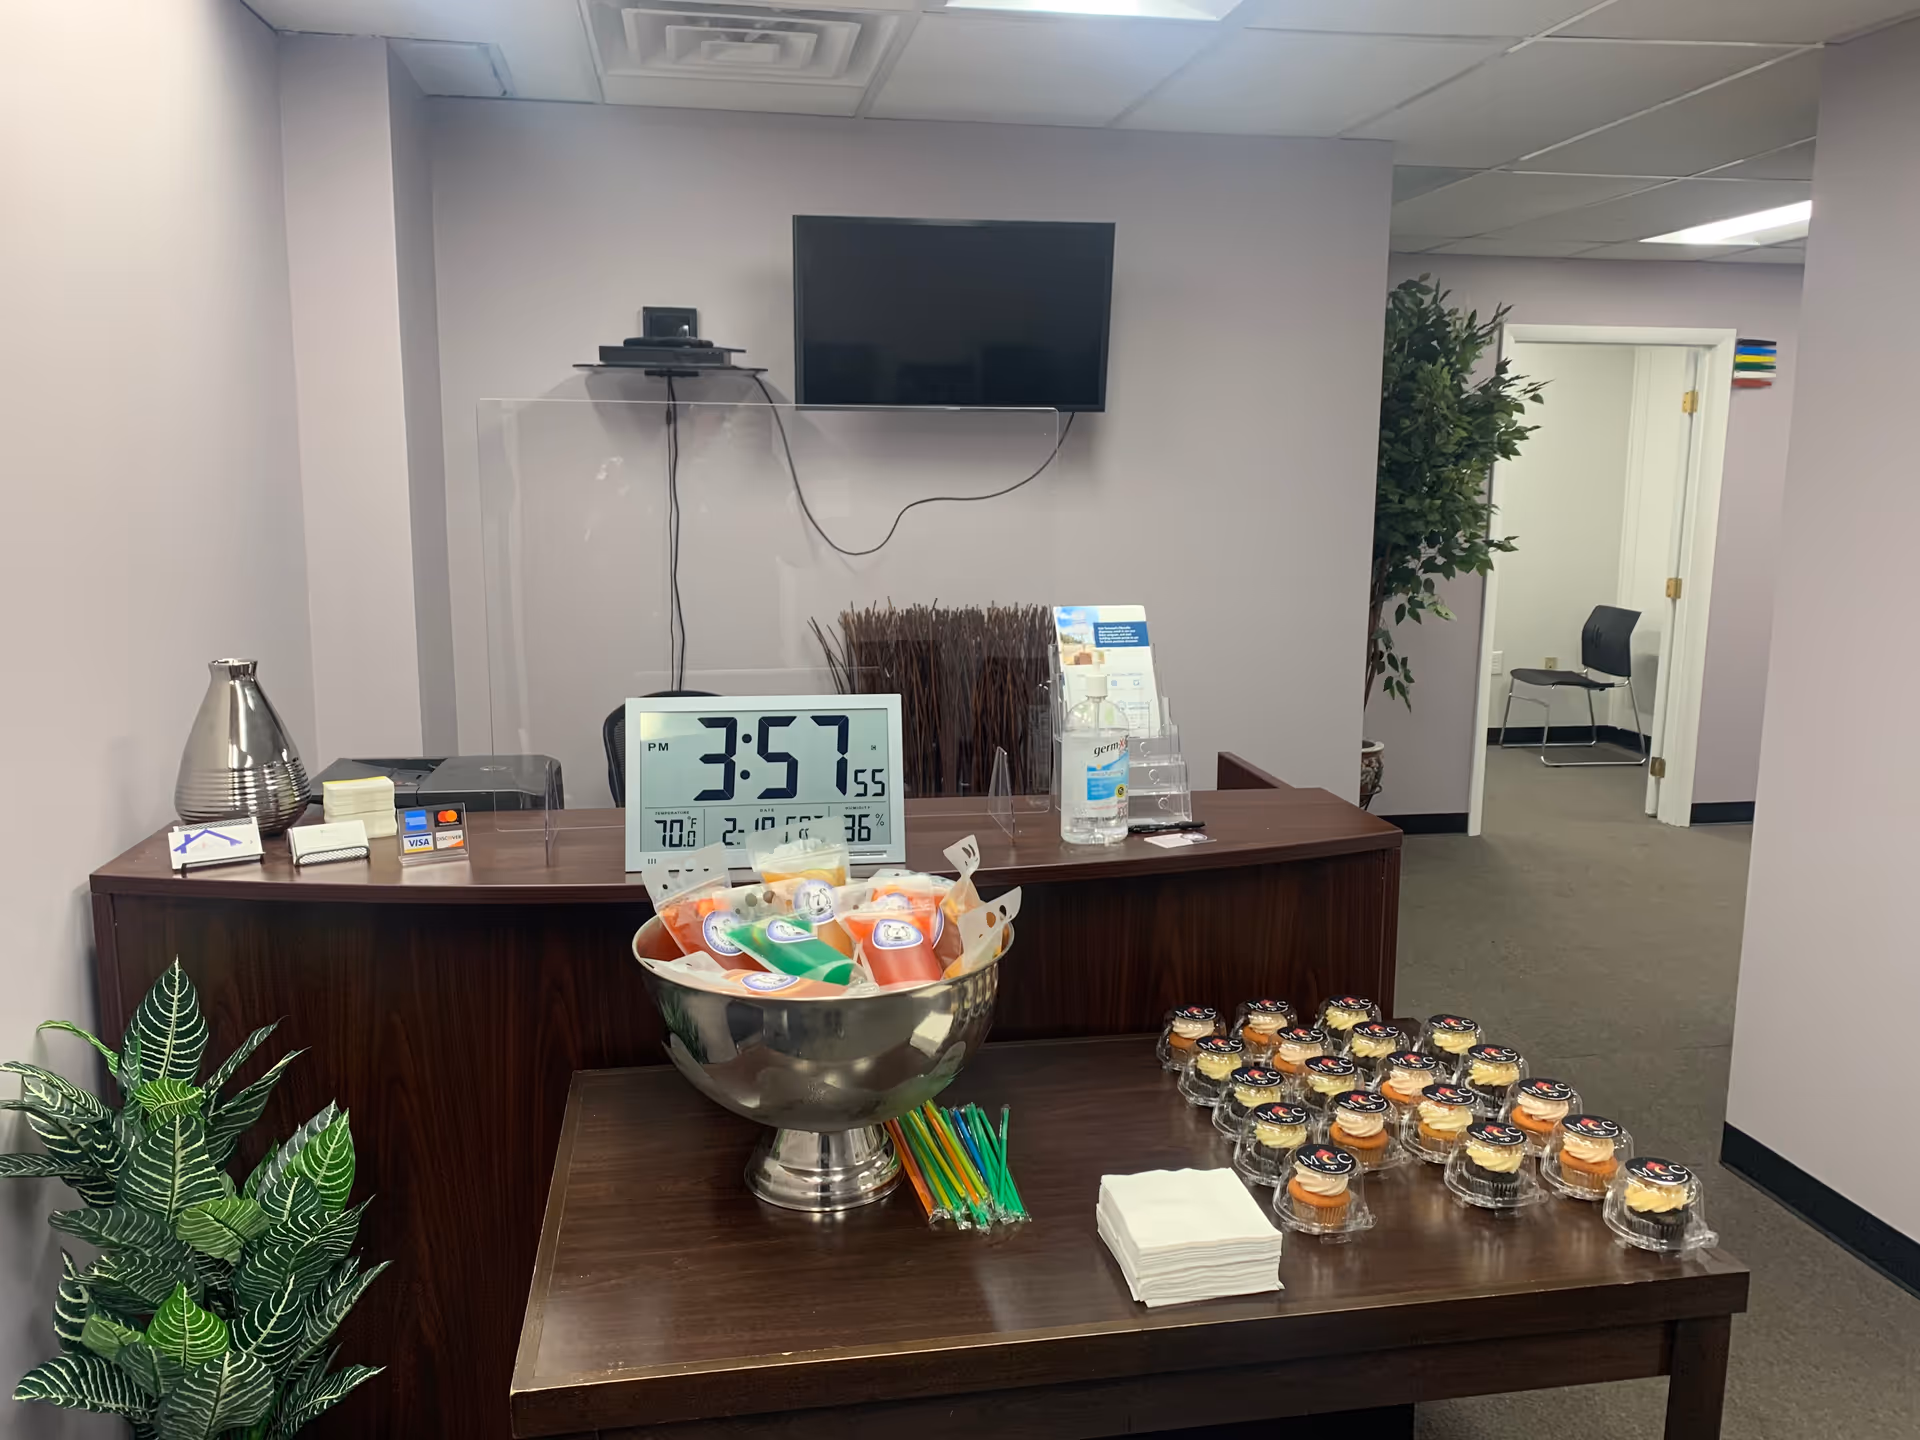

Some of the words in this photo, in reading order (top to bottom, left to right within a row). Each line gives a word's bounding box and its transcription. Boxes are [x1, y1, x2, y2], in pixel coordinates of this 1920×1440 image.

[648, 742, 669, 752] PM
[692, 715, 849, 801] 3:57
[853, 768, 886, 798] 55
[409, 839, 430, 847] VISA
